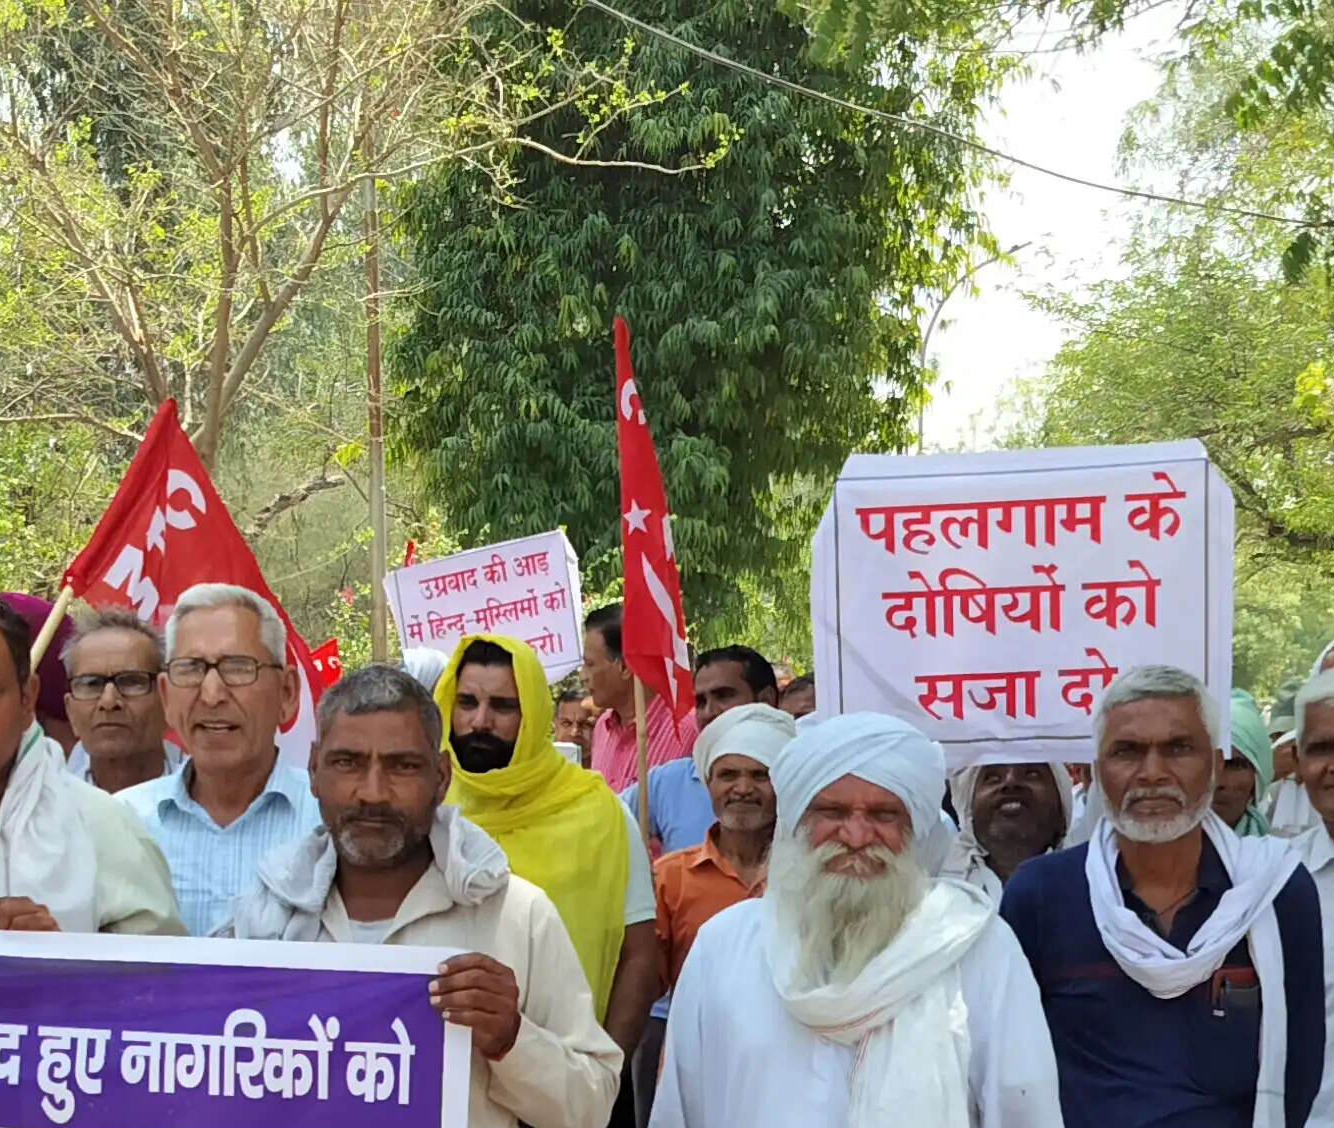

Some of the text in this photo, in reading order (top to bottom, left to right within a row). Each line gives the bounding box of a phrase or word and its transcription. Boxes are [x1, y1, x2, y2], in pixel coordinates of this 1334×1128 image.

[855, 472, 1185, 555] पहलगाम के
[419, 552, 549, 600] उग्रवाद की आड़
[882, 560, 1161, 638] दोषियों को
[407, 614, 423, 642] में
[544, 582, 567, 610] को
[917, 672, 1040, 719] सजा
[38, 1026, 111, 1124] हुए
[121, 1009, 339, 1099] नागरिकों
[345, 1018, 415, 1104] को
